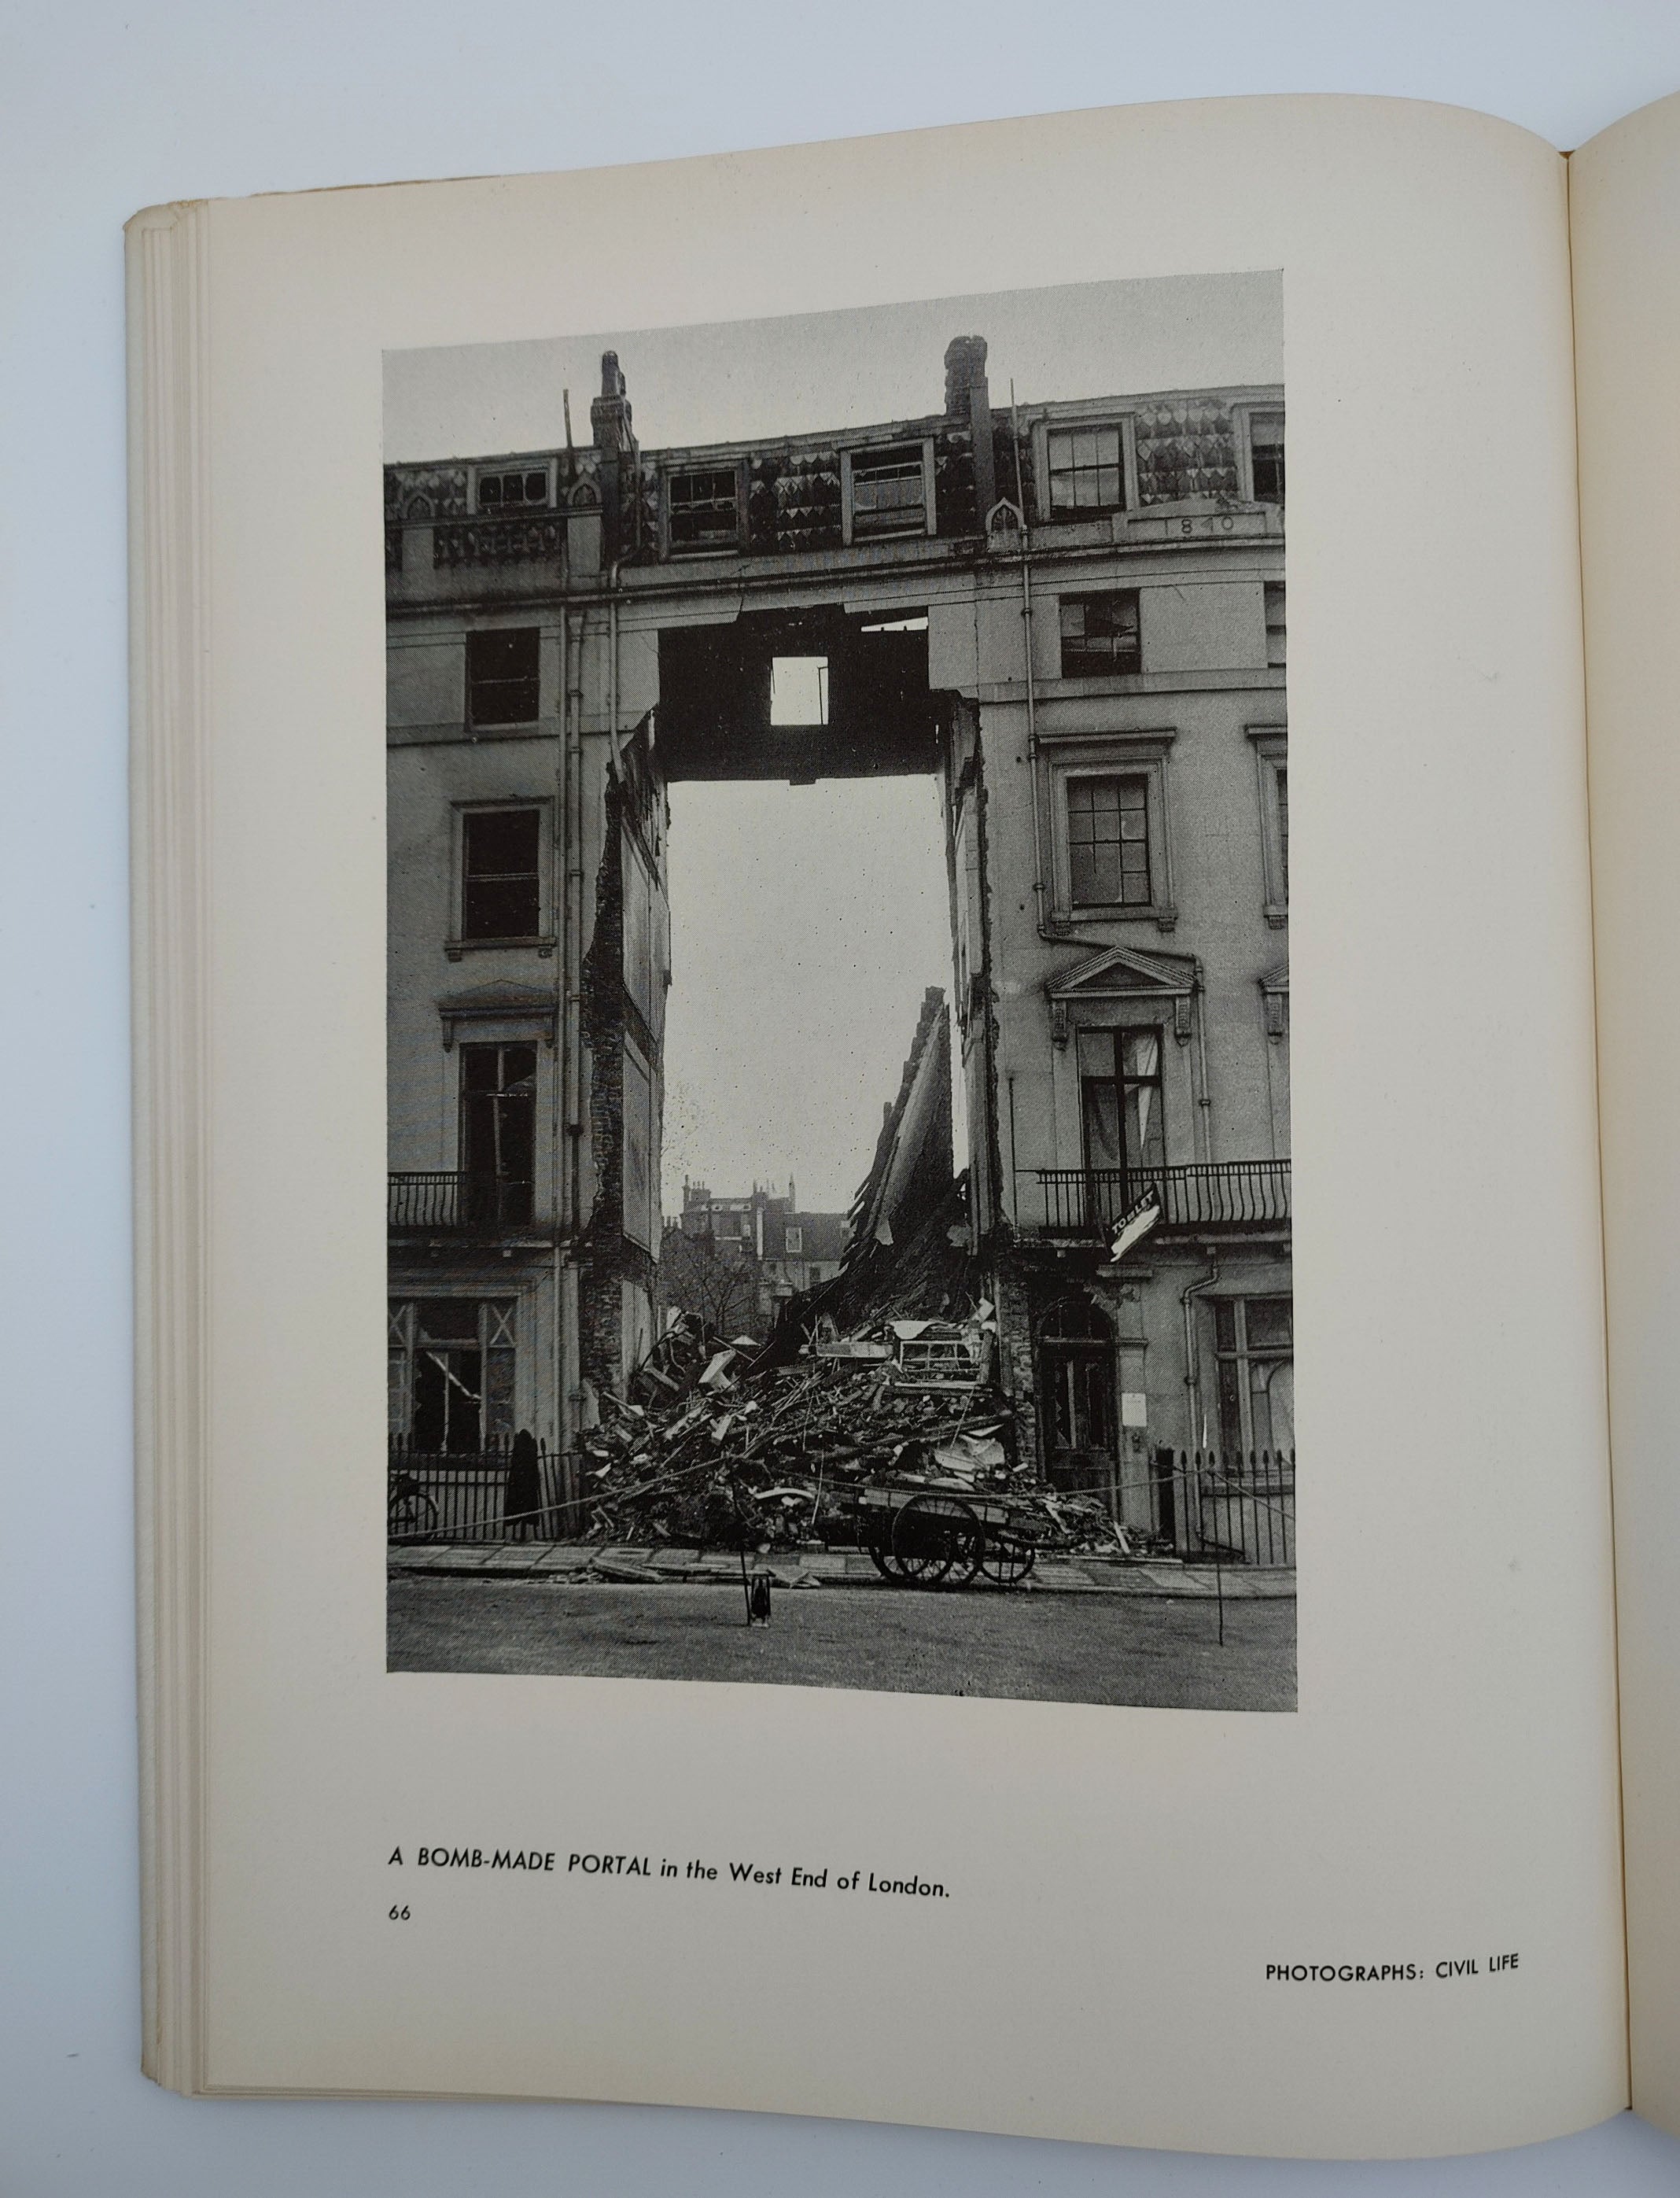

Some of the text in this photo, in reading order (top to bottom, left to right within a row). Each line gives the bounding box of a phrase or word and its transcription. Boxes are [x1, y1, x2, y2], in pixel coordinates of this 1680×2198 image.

[1111, 1189, 1154, 1234] TO LET
[387, 1846, 950, 1898] A BOMB-MADE PORTAL in the West End of London.
[389, 1905, 411, 1921] 66
[1266, 1953, 1519, 1982] PHOTOGRAPHS: CIVIL LIFE
